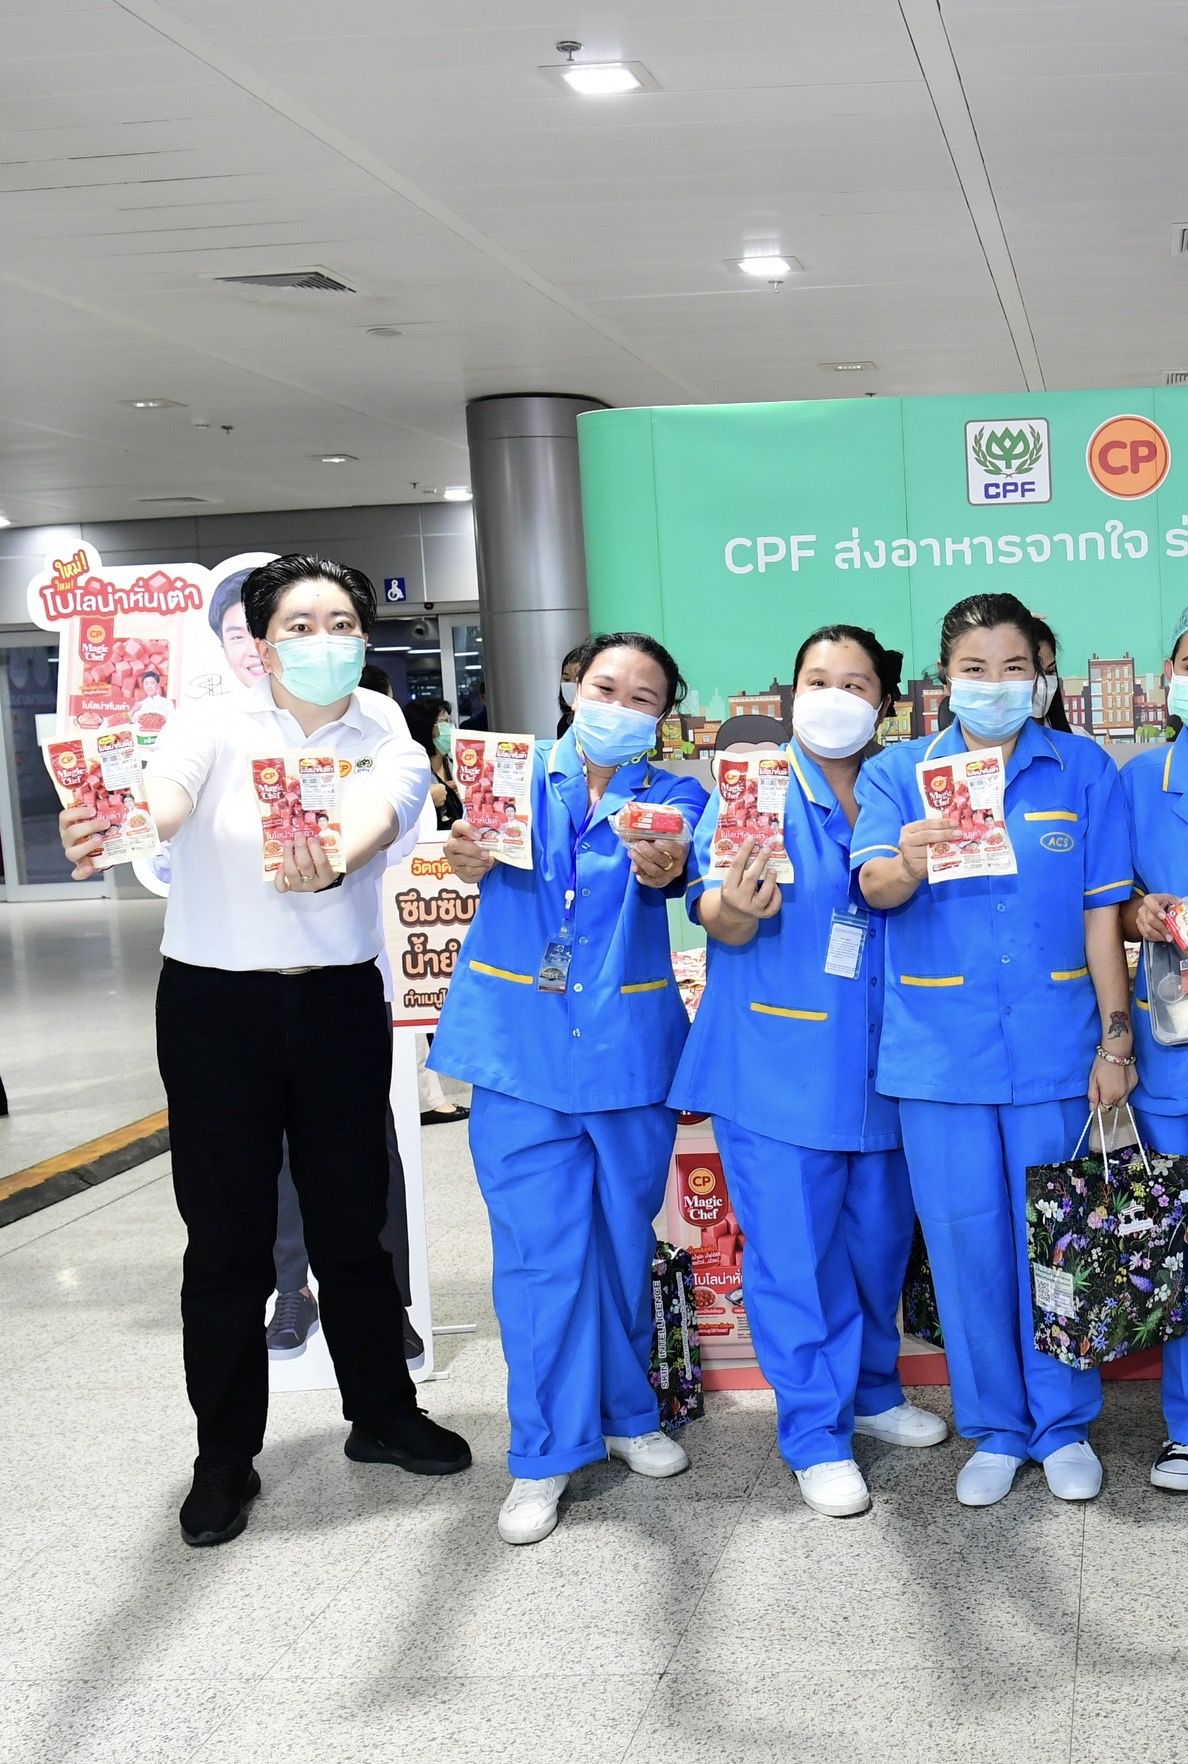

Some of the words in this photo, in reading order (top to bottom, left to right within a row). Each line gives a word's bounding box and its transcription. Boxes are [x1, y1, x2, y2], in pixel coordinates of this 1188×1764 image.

[1098, 440, 1157, 475] CP
[984, 481, 1036, 500] CPF
[724, 534, 817, 575] CPF
[834, 519, 1149, 569] ส่งอาหารจากใจ
[43, 579, 199, 616] โบโลน่าหั่นเต๋า
[90, 630, 102, 639] CP
[82, 643, 109, 654] Magic
[85, 652, 105, 661] Chef
[1048, 837, 1069, 848] ACS
[412, 858, 454, 880] วัตถุดิ
[399, 891, 478, 922] ซึมซับ
[692, 1176, 711, 1187] CP
[684, 1195, 723, 1209] Magic
[689, 1208, 719, 1220] Chef
[693, 1269, 743, 1285] โบโลน่าหั่
[653, 1281, 667, 1358] INTELLIGENCE
[661, 1363, 669, 1389] SKIN
